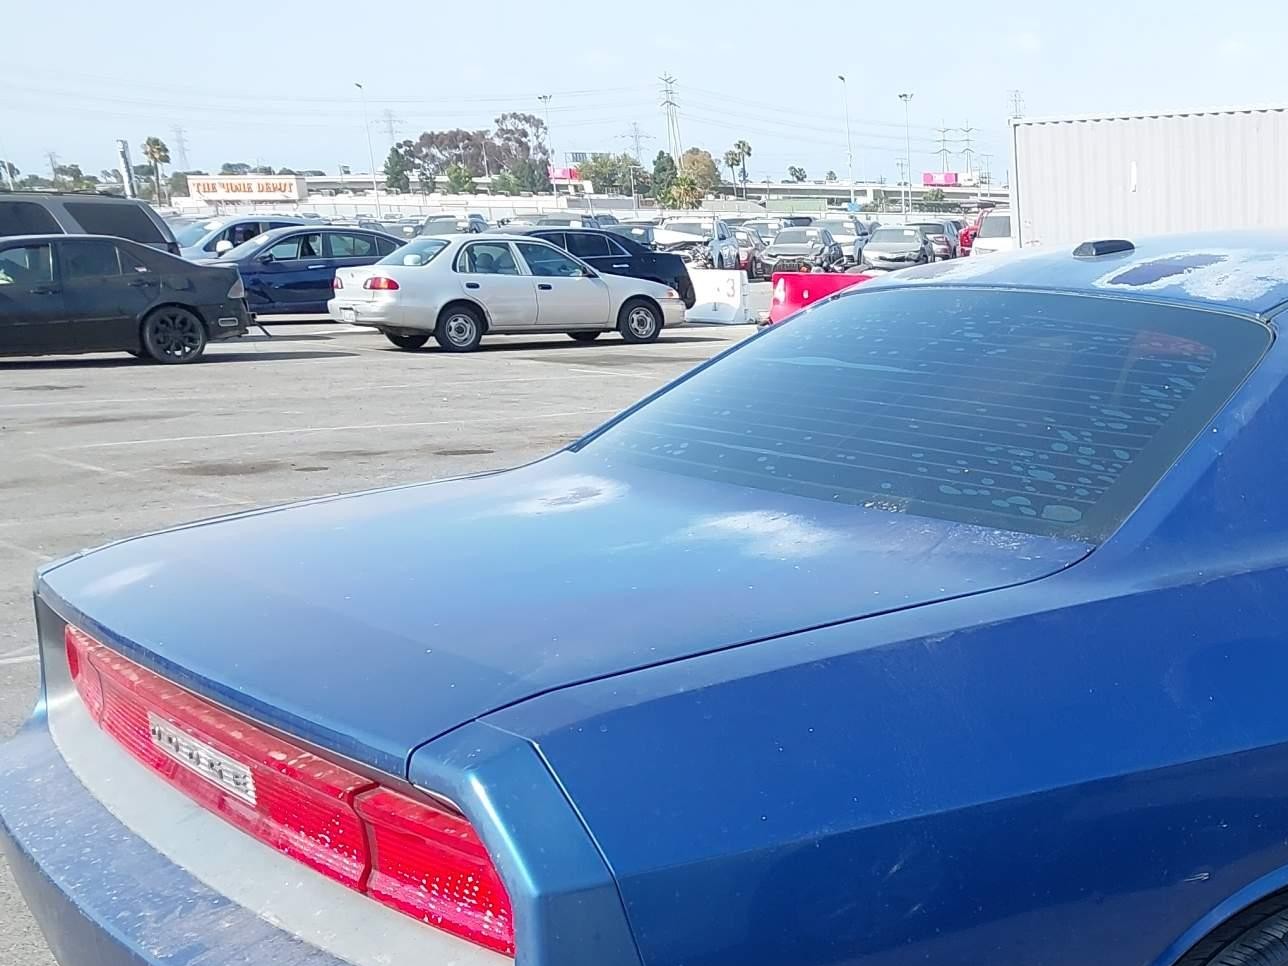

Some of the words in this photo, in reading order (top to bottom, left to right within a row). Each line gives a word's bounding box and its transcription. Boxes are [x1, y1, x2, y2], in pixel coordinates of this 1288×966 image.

[194, 182, 217, 193] THE
[257, 182, 293, 193] DEPOT
[726, 278, 735, 298] 3
